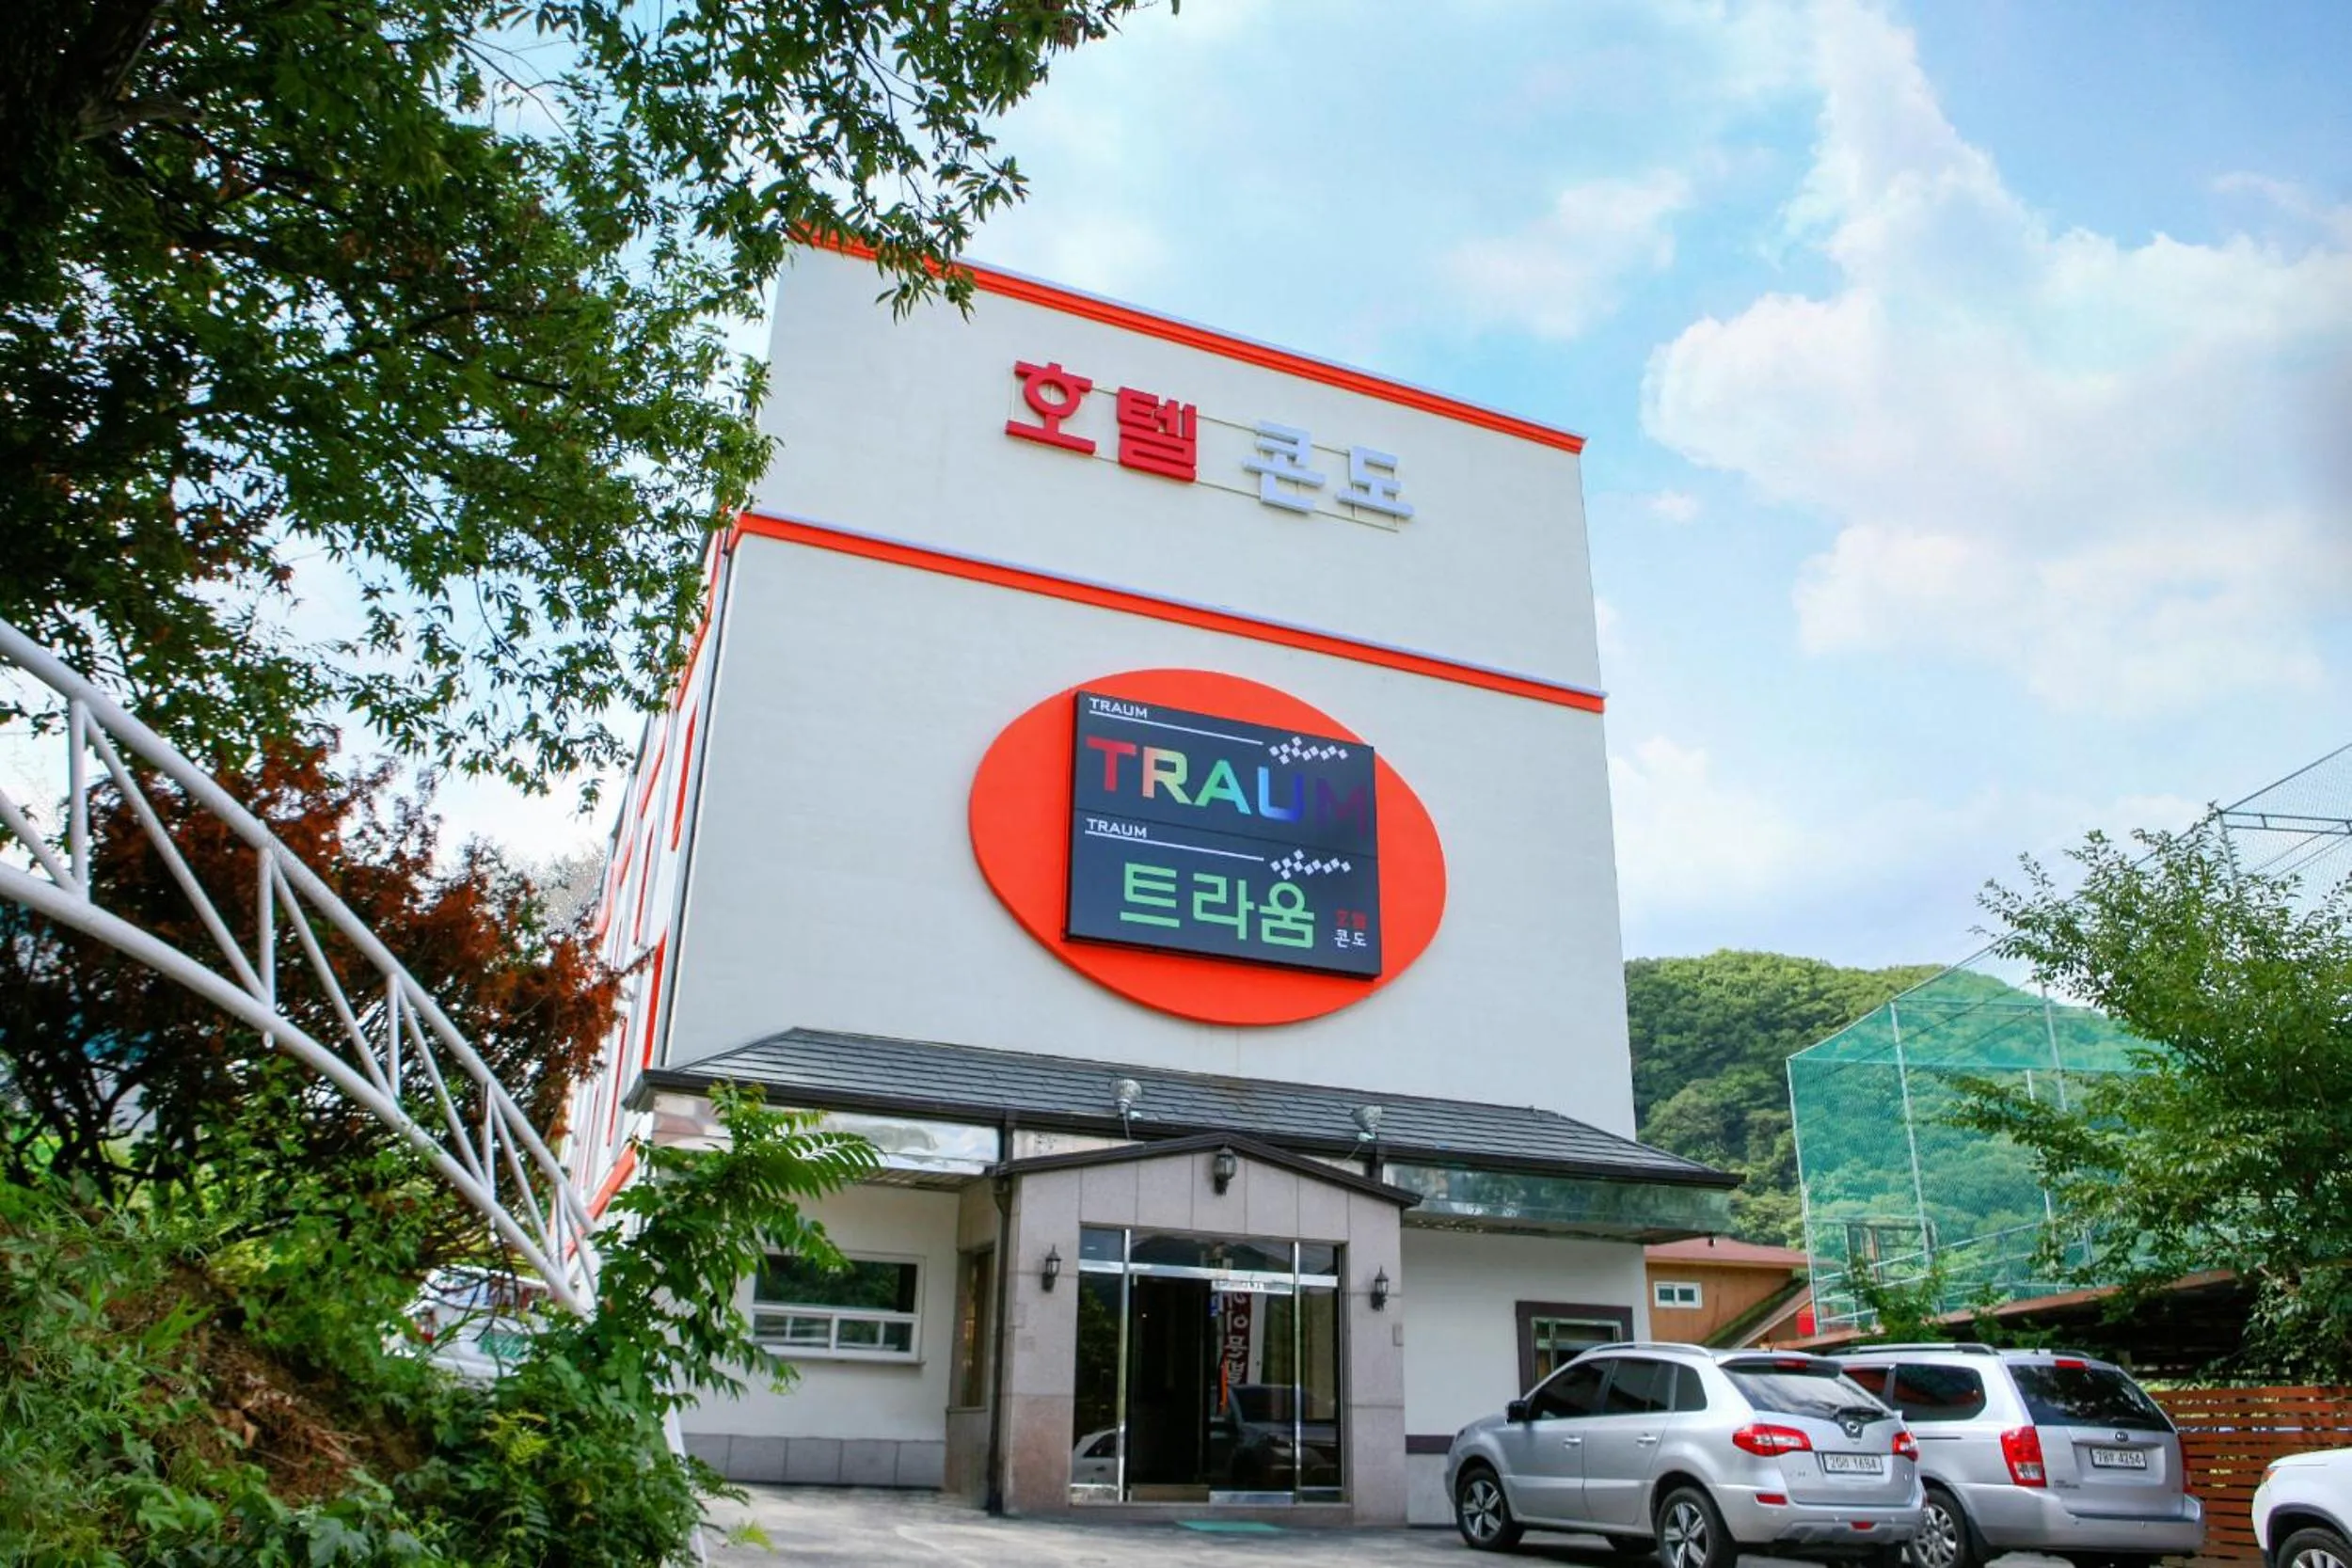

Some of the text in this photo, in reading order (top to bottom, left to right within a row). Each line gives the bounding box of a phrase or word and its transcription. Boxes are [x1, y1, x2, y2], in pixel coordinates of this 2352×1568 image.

[1005, 360, 1414, 519] 호텔 콘도
[1089, 697, 1148, 719] TRAUM
[1086, 736, 1367, 837] TRAUM
[1086, 817, 1147, 839] TRAUM
[1120, 863, 1315, 948] 트라움
[1334, 928, 1367, 948] 콘도
